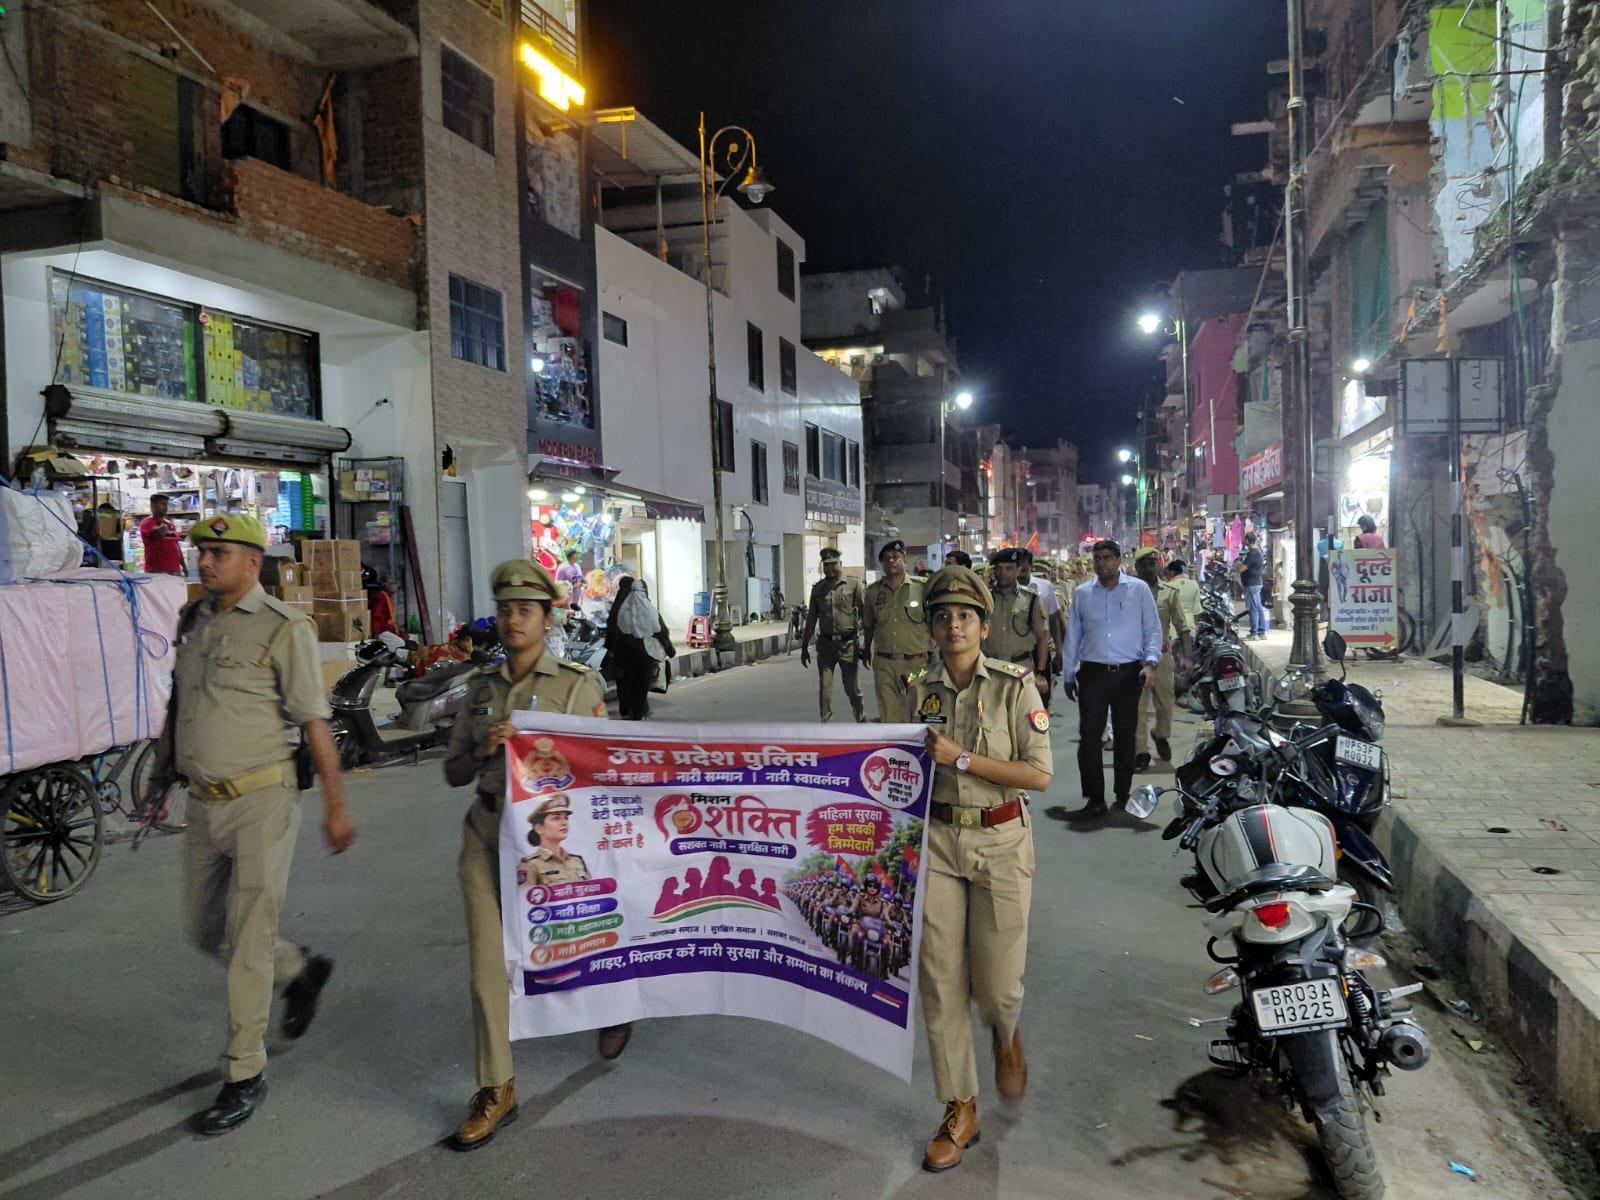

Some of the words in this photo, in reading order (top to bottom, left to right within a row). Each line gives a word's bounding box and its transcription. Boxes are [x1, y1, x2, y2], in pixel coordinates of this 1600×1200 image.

[1354, 552, 1393, 583] दूल्हे
[1349, 585, 1394, 604] राजा
[607, 746, 665, 766] उत्तर
[672, 743, 735, 767] प्रदेश
[742, 745, 819, 770] पुलिस
[592, 769, 618, 782] नारी
[675, 769, 701, 782] नारी
[704, 771, 743, 782] सम्मान
[765, 769, 790, 782] नारी
[591, 795, 608, 806] बेटी
[611, 795, 642, 805] बचाओ
[691, 793, 730, 805] मिशन
[592, 807, 610, 820] बेटी
[703, 794, 800, 840] शक्ति
[818, 806, 852, 821] महिला
[855, 809, 882, 823] सुरक्षा
[603, 822, 622, 835] बेटी
[625, 820, 633, 834] है
[827, 823, 843, 834] हम
[596, 837, 609, 850] तो
[612, 837, 633, 849] कल
[636, 833, 644, 848] है
[678, 840, 707, 851] सशक्त
[709, 839, 728, 850] नारी
[738, 841, 769, 855] सुरक्षित
[771, 843, 789, 855] नारी
[828, 836, 875, 853] जिम्मेदारी
[555, 903, 574, 917] नारी
[577, 903, 600, 916] शिक्षा
[557, 924, 575, 936] नारी
[589, 955, 626, 973] आइए,
[629, 948, 673, 964] मिलकर
[676, 943, 697, 958] करें
[698, 943, 723, 958] नारी
[726, 947, 760, 960] सुरक्षा
[763, 946, 783, 965] और
[785, 956, 817, 976] सम्मान
[819, 966, 833, 981] का
[835, 971, 868, 994] संकल्प
[1270, 983, 1331, 1006] BR03A
[1274, 1001, 1334, 1024] H3225
